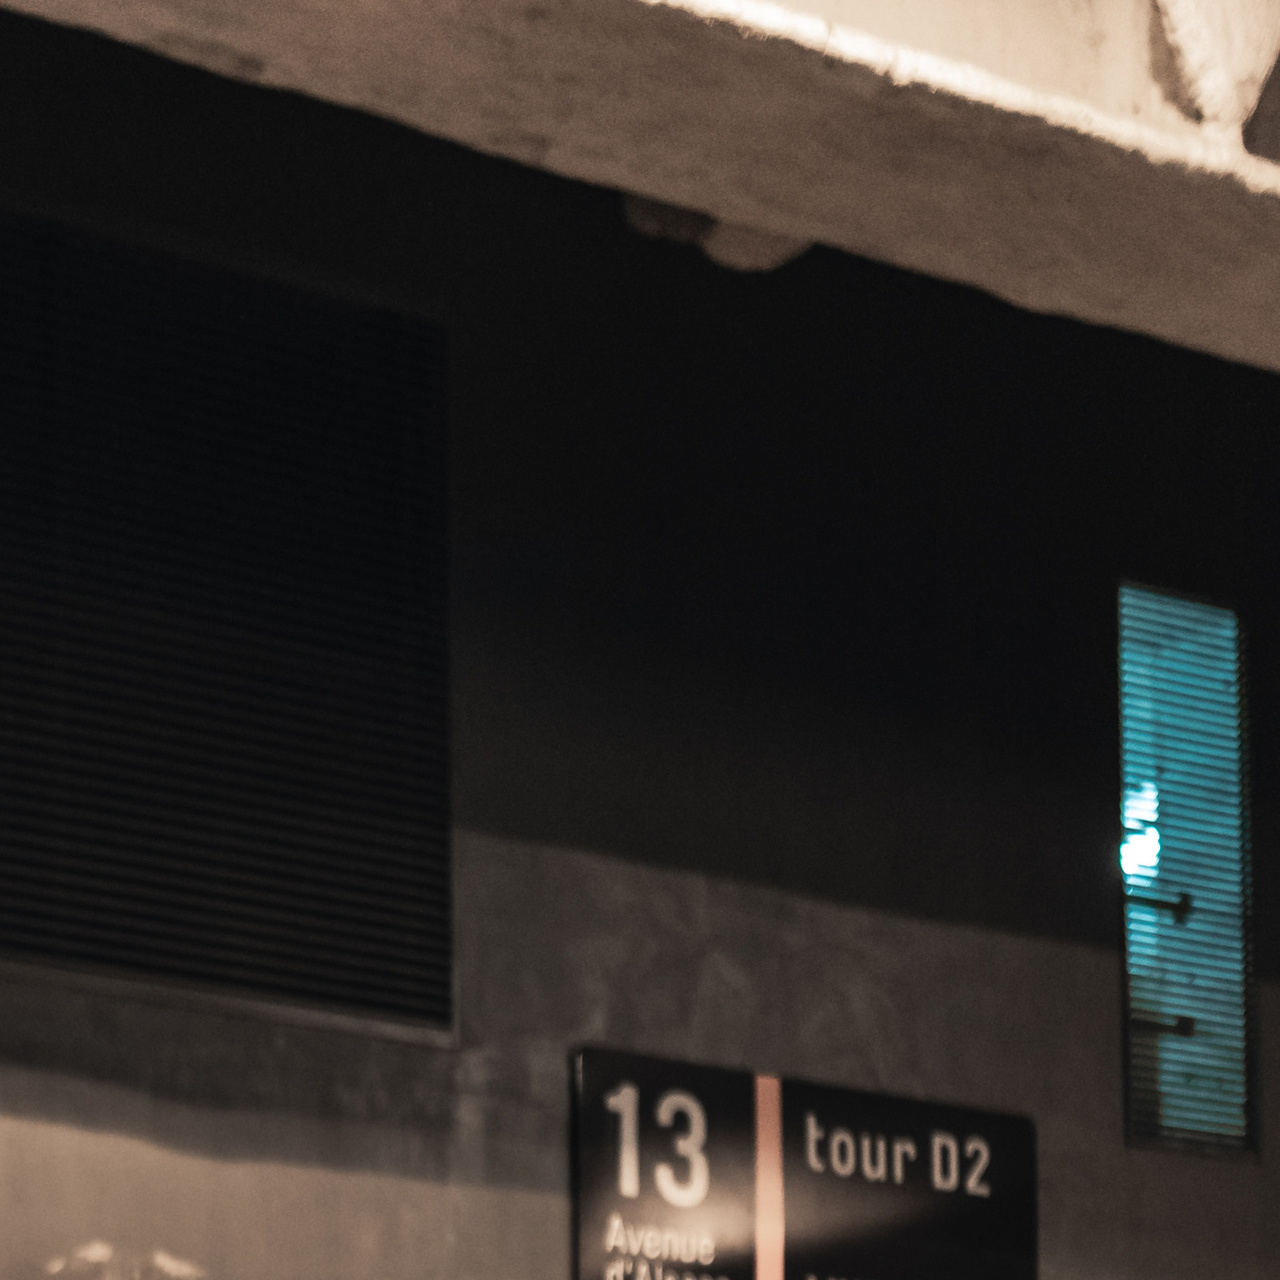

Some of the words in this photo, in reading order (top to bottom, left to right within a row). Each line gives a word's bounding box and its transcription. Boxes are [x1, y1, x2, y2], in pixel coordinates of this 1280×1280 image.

[604, 1081, 711, 1208] 13
[805, 1111, 917, 1185] tour
[931, 1130, 991, 1198] D2
[605, 1212, 716, 1266] Avenue
